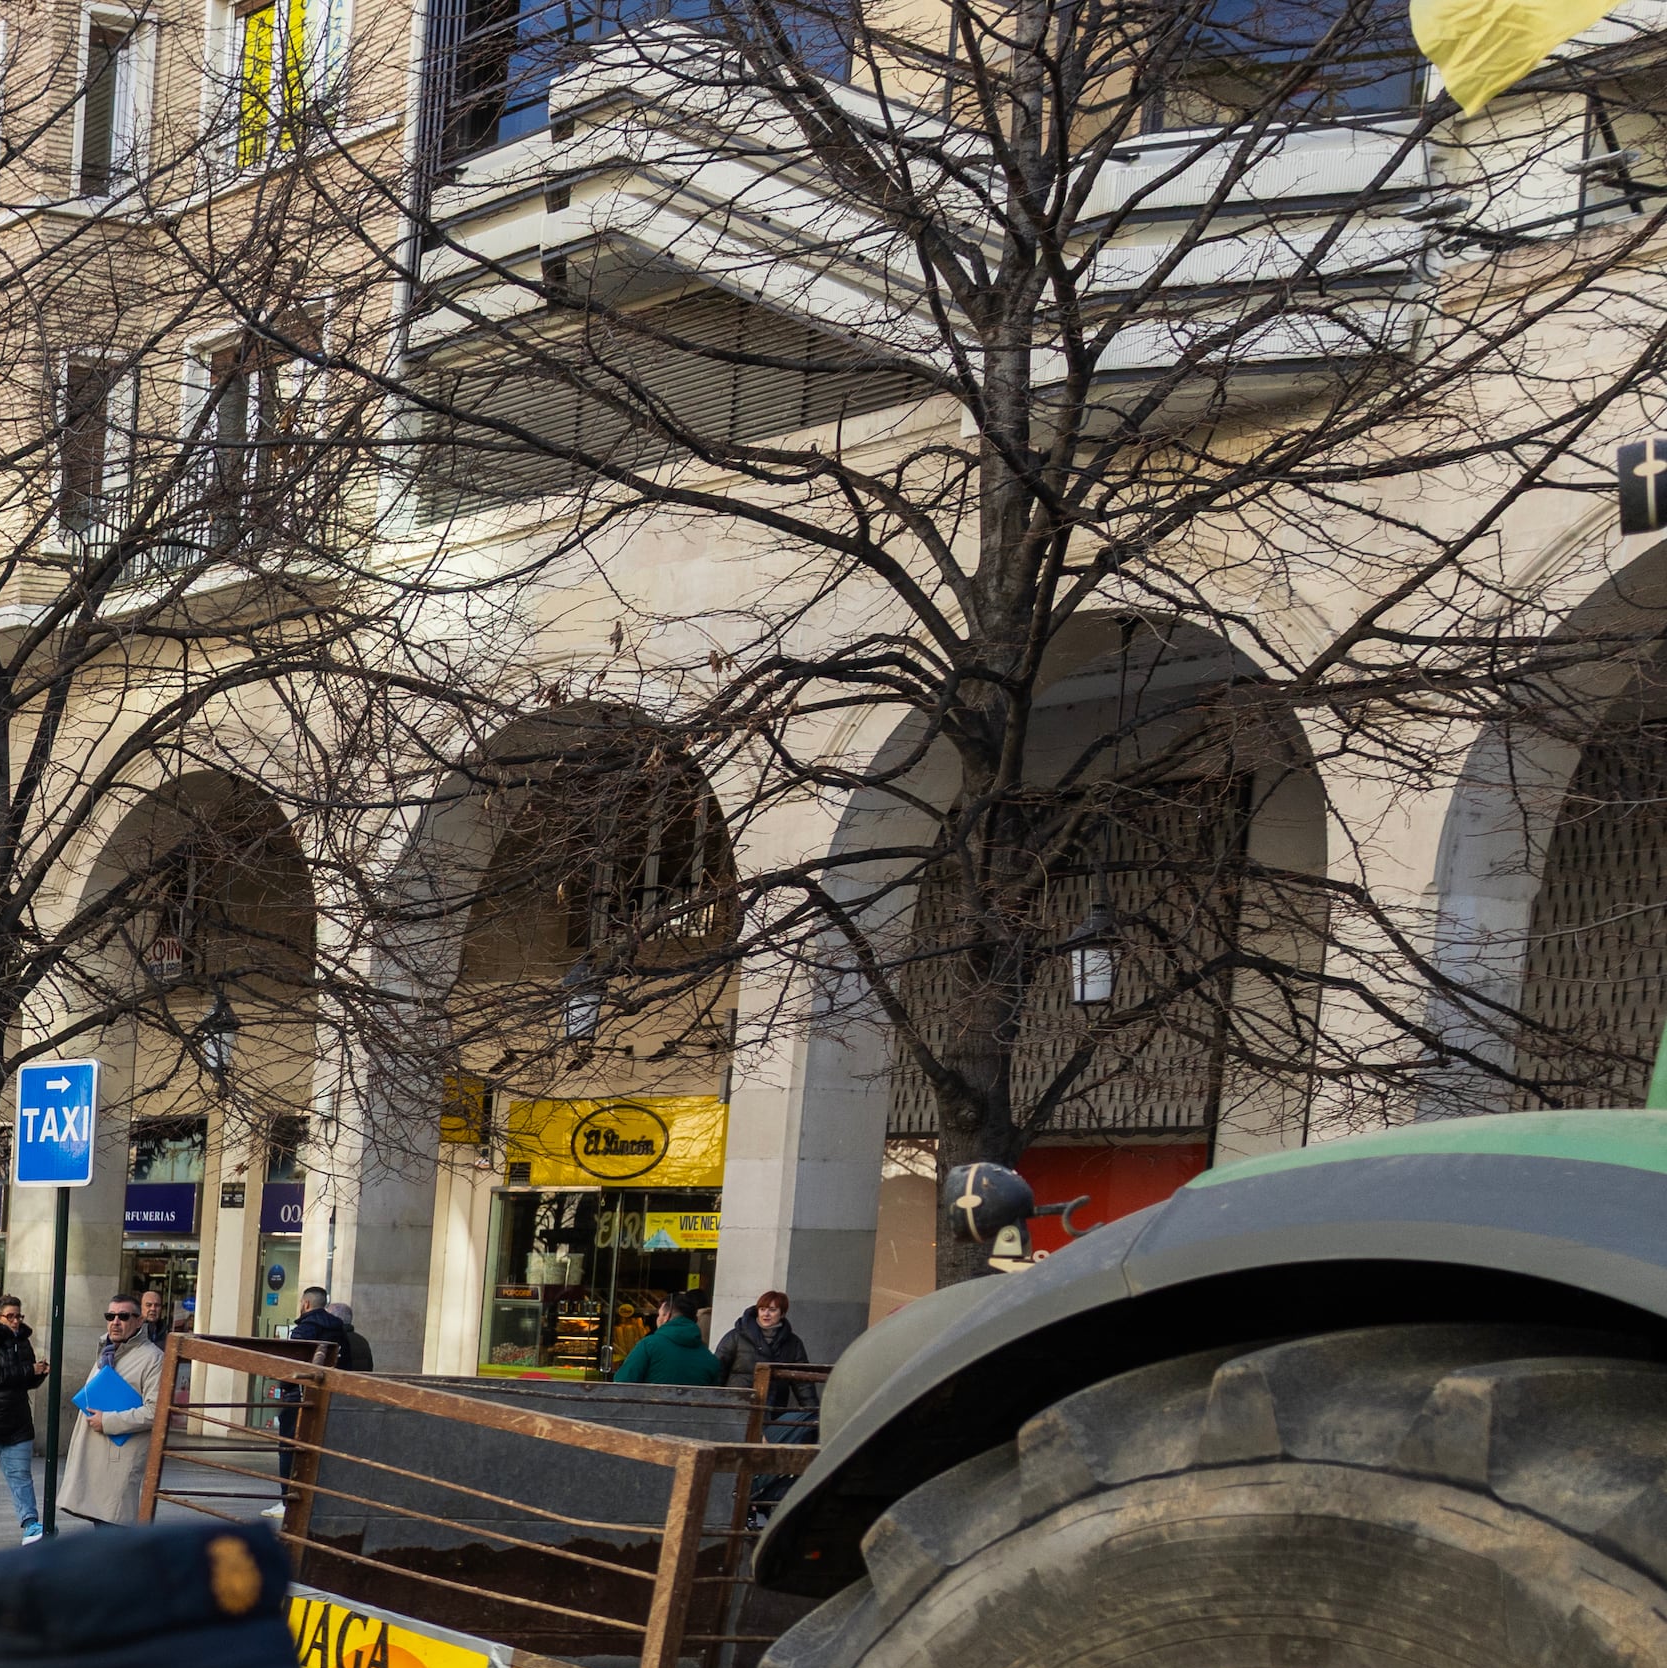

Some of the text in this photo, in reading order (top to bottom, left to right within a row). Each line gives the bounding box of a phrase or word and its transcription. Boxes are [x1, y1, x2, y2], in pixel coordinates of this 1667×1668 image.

[22, 1105, 90, 1143] TAXI
[583, 1129, 601, 1155] El
[125, 1211, 176, 1222] RFUMERIAS
[680, 1215, 699, 1231] VIVE
